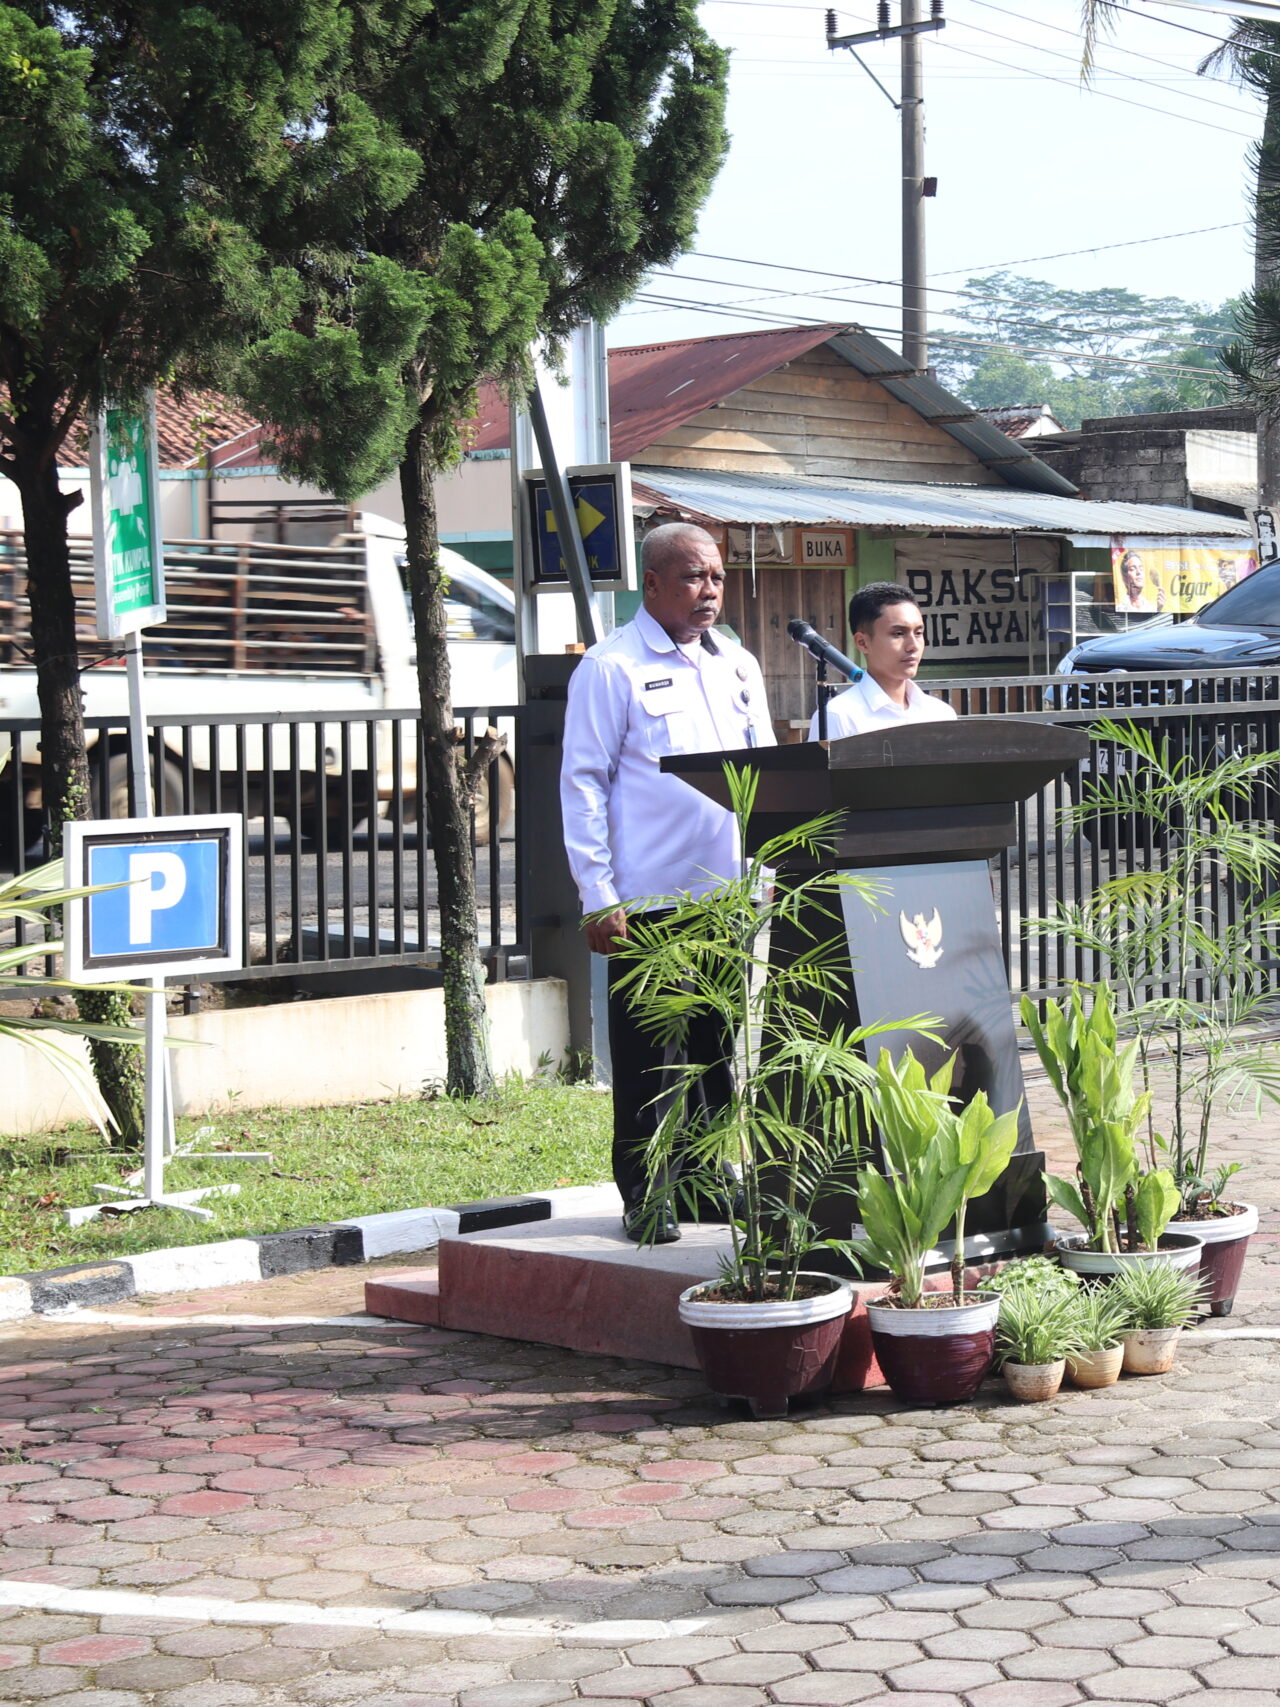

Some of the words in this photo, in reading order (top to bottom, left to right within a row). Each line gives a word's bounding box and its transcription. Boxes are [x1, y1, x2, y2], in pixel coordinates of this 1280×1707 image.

[806, 540, 843, 557] BUKA
[113, 585, 136, 603] ssembly
[906, 568, 1041, 607] BAKSO
[1170, 574, 1213, 602] Cigar
[966, 610, 1045, 644] AYAM
[129, 852, 186, 944] P
